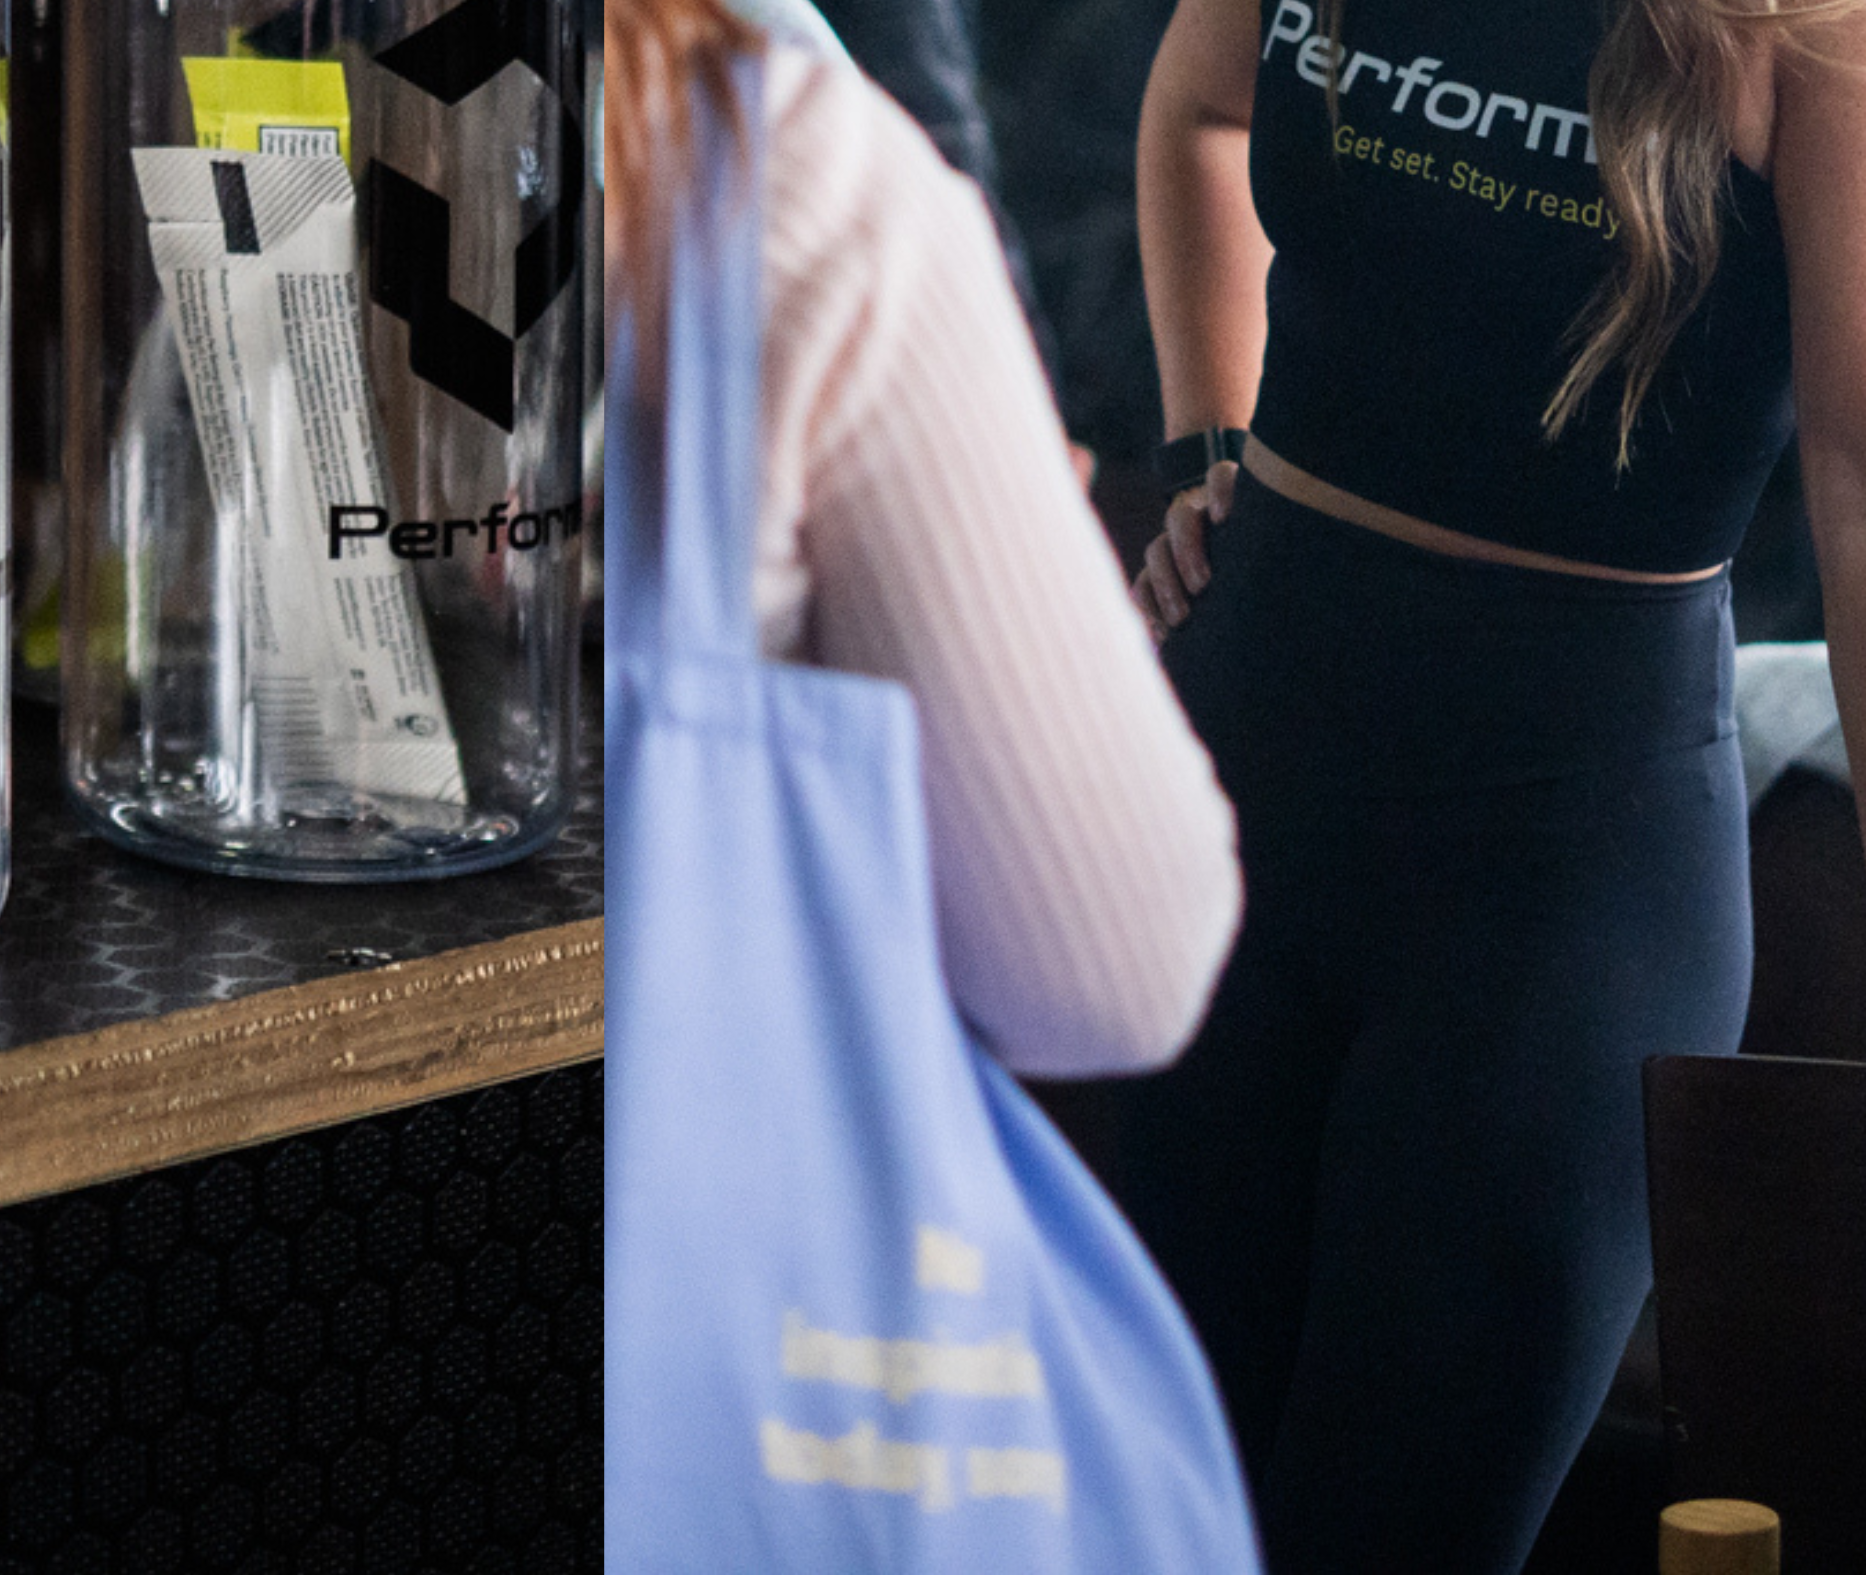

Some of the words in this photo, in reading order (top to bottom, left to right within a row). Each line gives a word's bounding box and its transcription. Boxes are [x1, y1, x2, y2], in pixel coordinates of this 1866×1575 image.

[1333, 124, 1384, 165] Get
[1389, 146, 1440, 183] set.
[1448, 159, 1517, 212] Stay
[1525, 188, 1622, 240] ready
